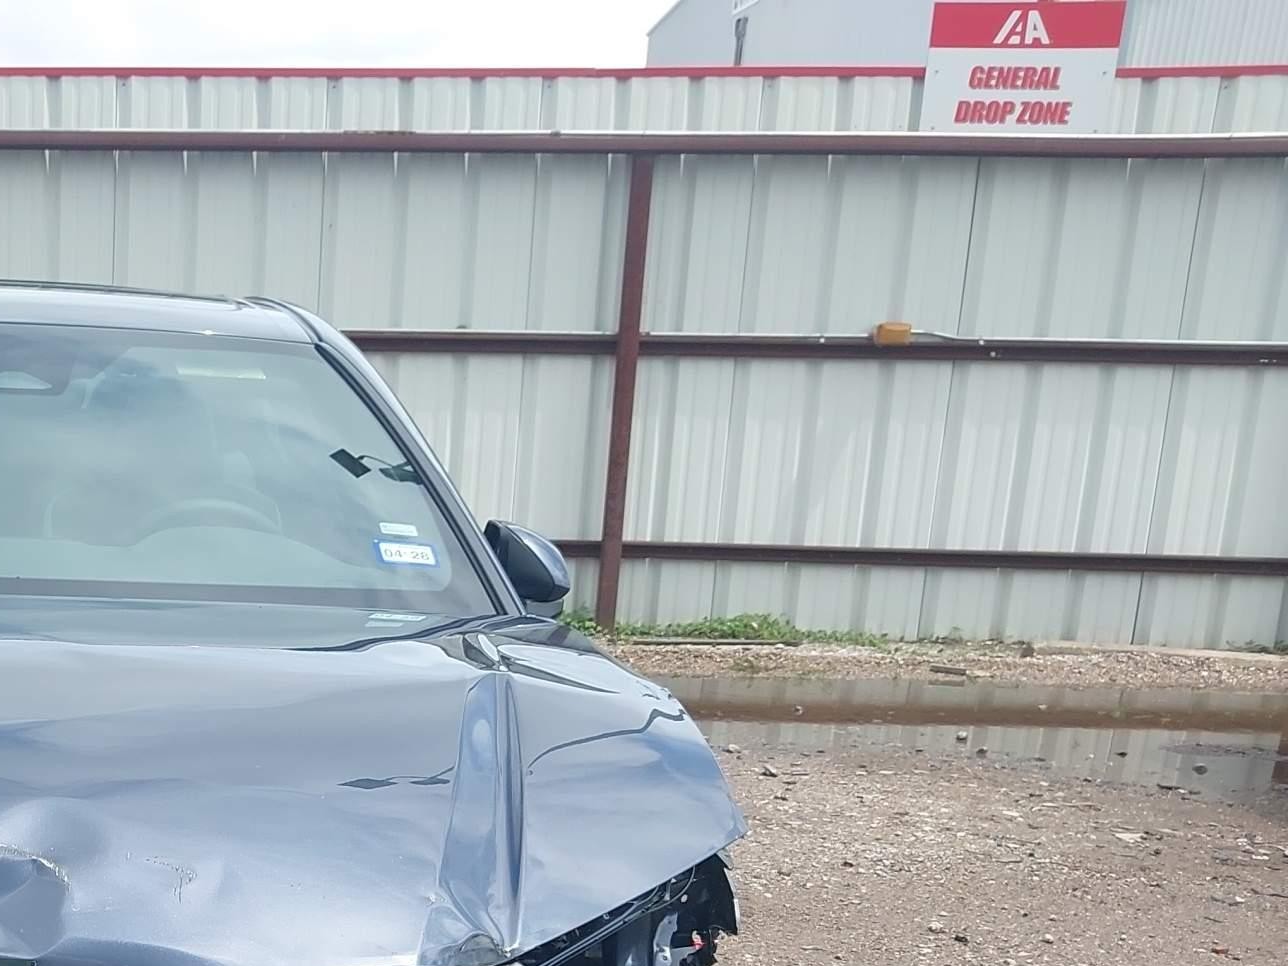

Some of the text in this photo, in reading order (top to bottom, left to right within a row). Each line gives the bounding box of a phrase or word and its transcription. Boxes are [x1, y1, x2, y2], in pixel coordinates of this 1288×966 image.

[968, 65, 1061, 90] GENERAL
[953, 100, 1073, 126] DROP ZONE
